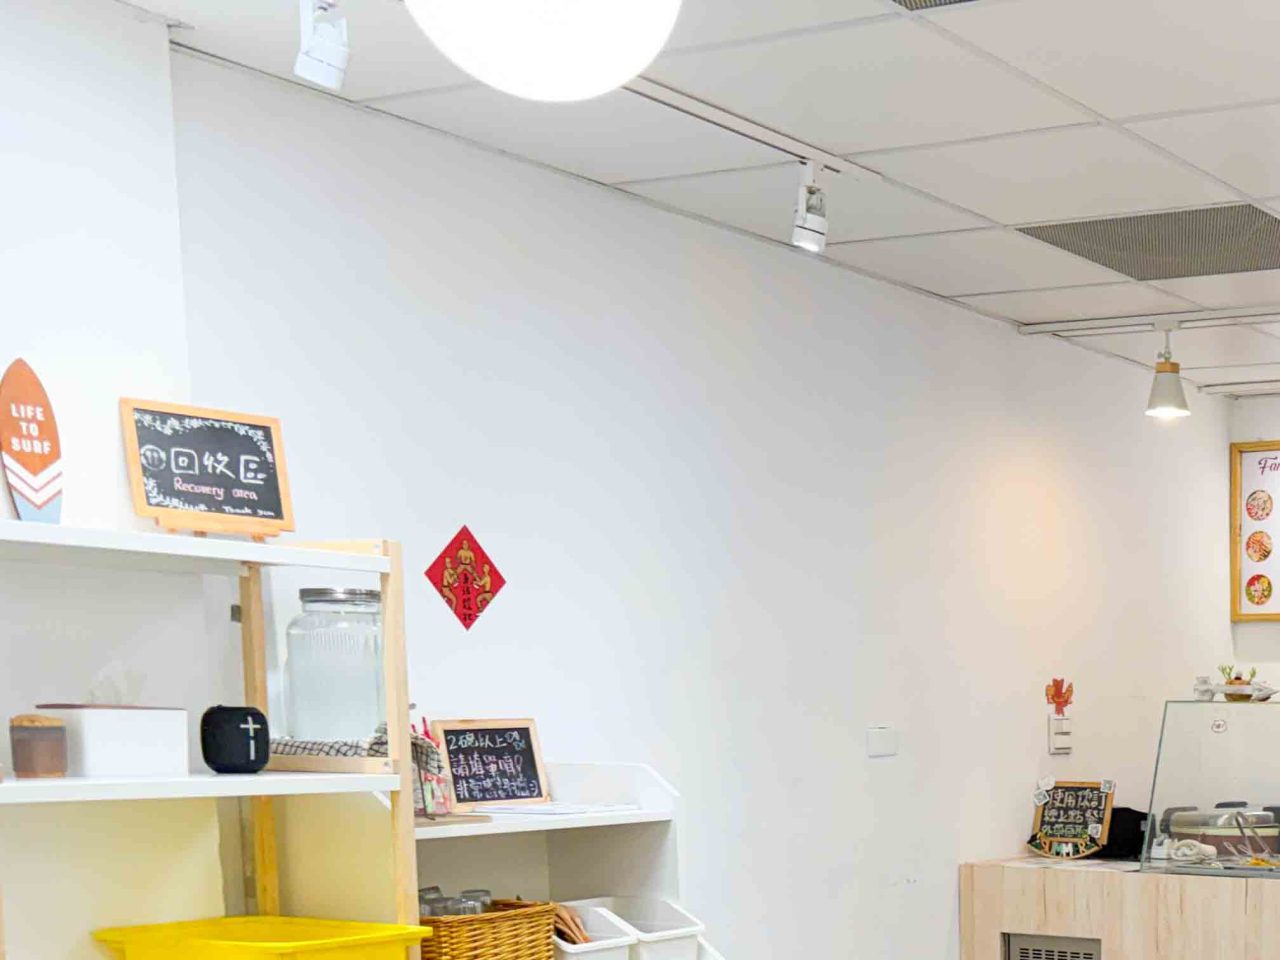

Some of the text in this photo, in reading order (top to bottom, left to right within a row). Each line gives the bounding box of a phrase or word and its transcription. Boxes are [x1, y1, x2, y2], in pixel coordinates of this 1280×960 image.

[11, 403, 45, 421] LIFE
[19, 422, 39, 436] TO
[10, 437, 51, 456] SURF
[173, 477, 258, 503] Recovery area
[222, 505, 252, 516] Thank
